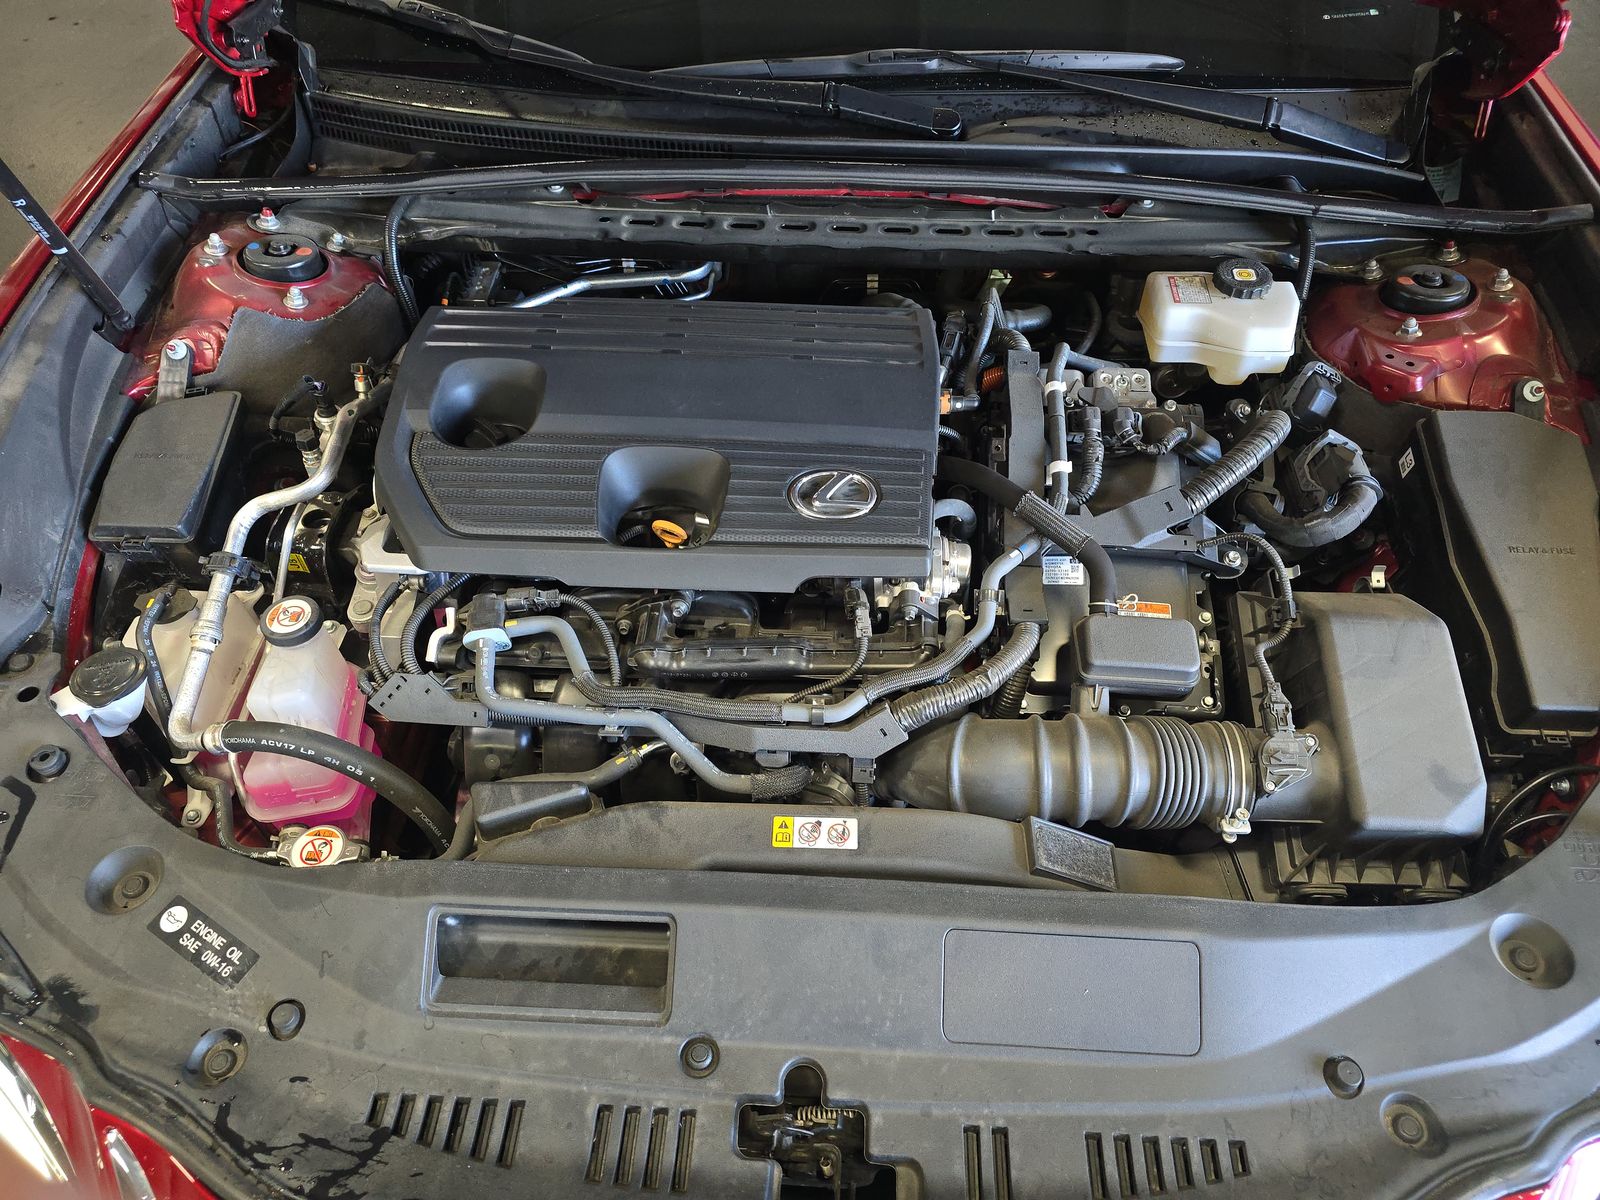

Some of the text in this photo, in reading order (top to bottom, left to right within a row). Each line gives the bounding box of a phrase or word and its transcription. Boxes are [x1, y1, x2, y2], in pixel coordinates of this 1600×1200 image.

[1508, 545, 1539, 554] RELAY
[1551, 546, 1576, 555] FUSE
[260, 738, 296, 750] ACV17
[300, 746, 316, 756] LP
[178, 933, 233, 977] SAE 0W-16
[190, 919, 243, 965] ENGINE OIL
